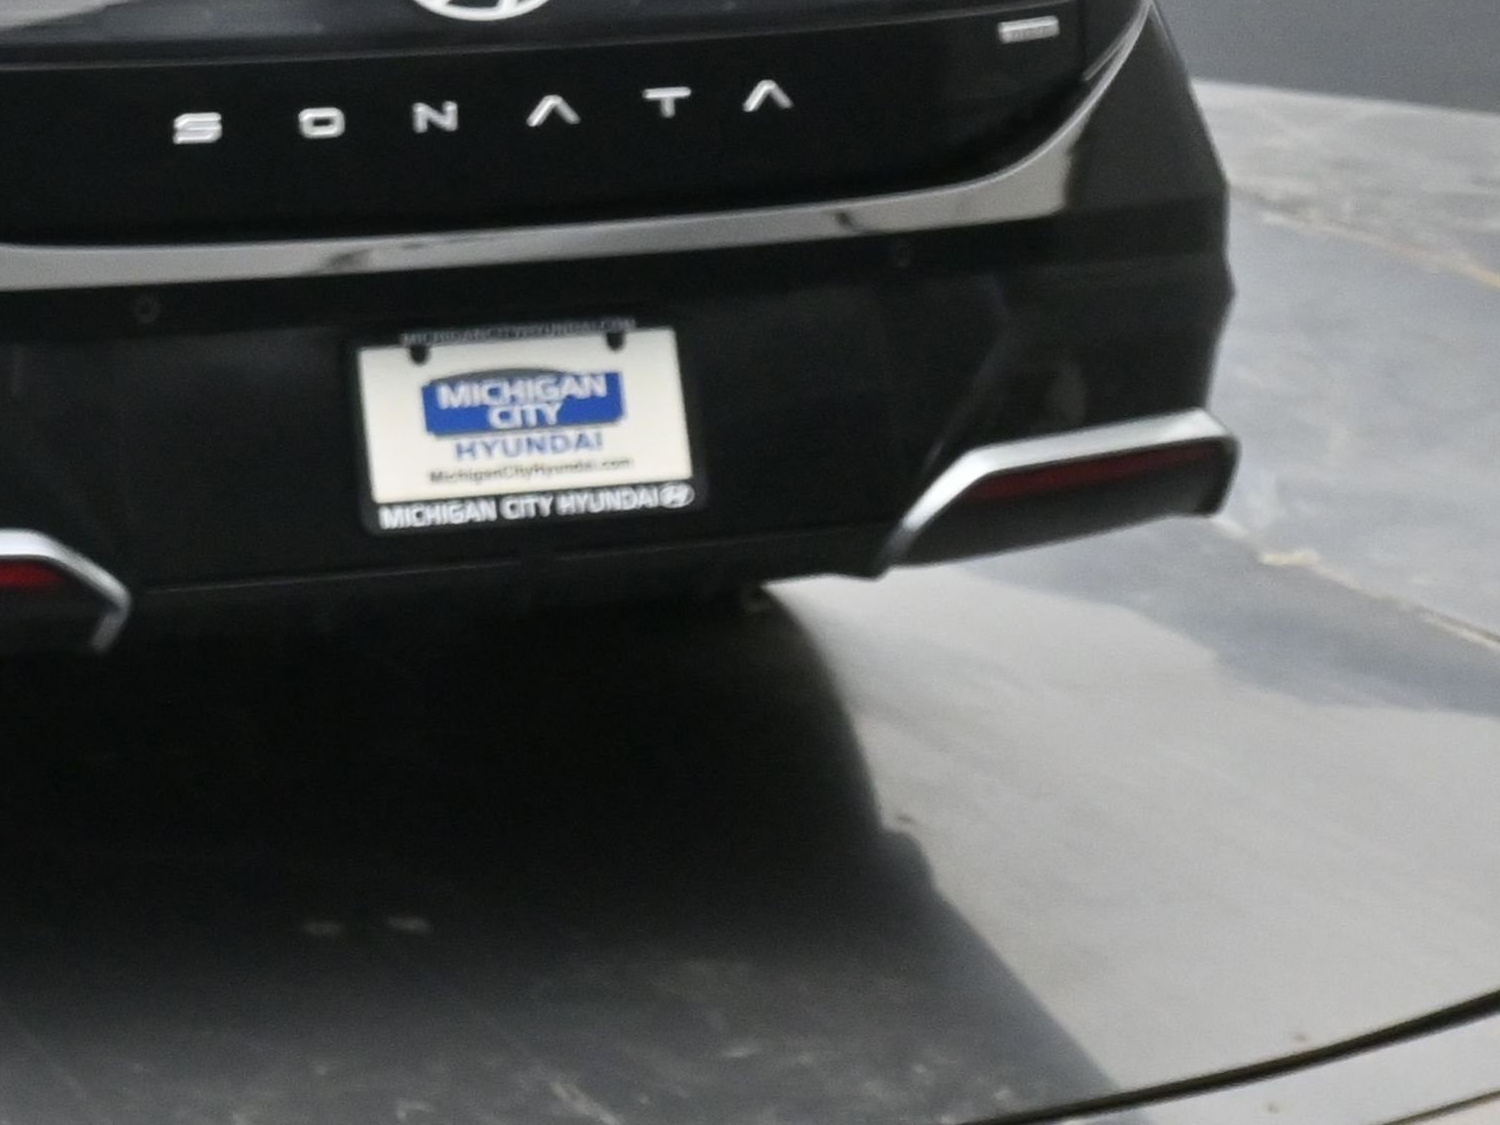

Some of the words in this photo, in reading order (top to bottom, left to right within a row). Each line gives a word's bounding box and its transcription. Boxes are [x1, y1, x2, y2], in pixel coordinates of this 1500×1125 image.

[173, 79, 793, 144] SONATA
[437, 374, 607, 409] MICHIGAN
[488, 403, 564, 429] CITY
[455, 431, 603, 461] HYUNDAI
[379, 498, 498, 529] MICHIGAN
[500, 493, 555, 520] CITY
[555, 485, 659, 516] HYUNDAI
